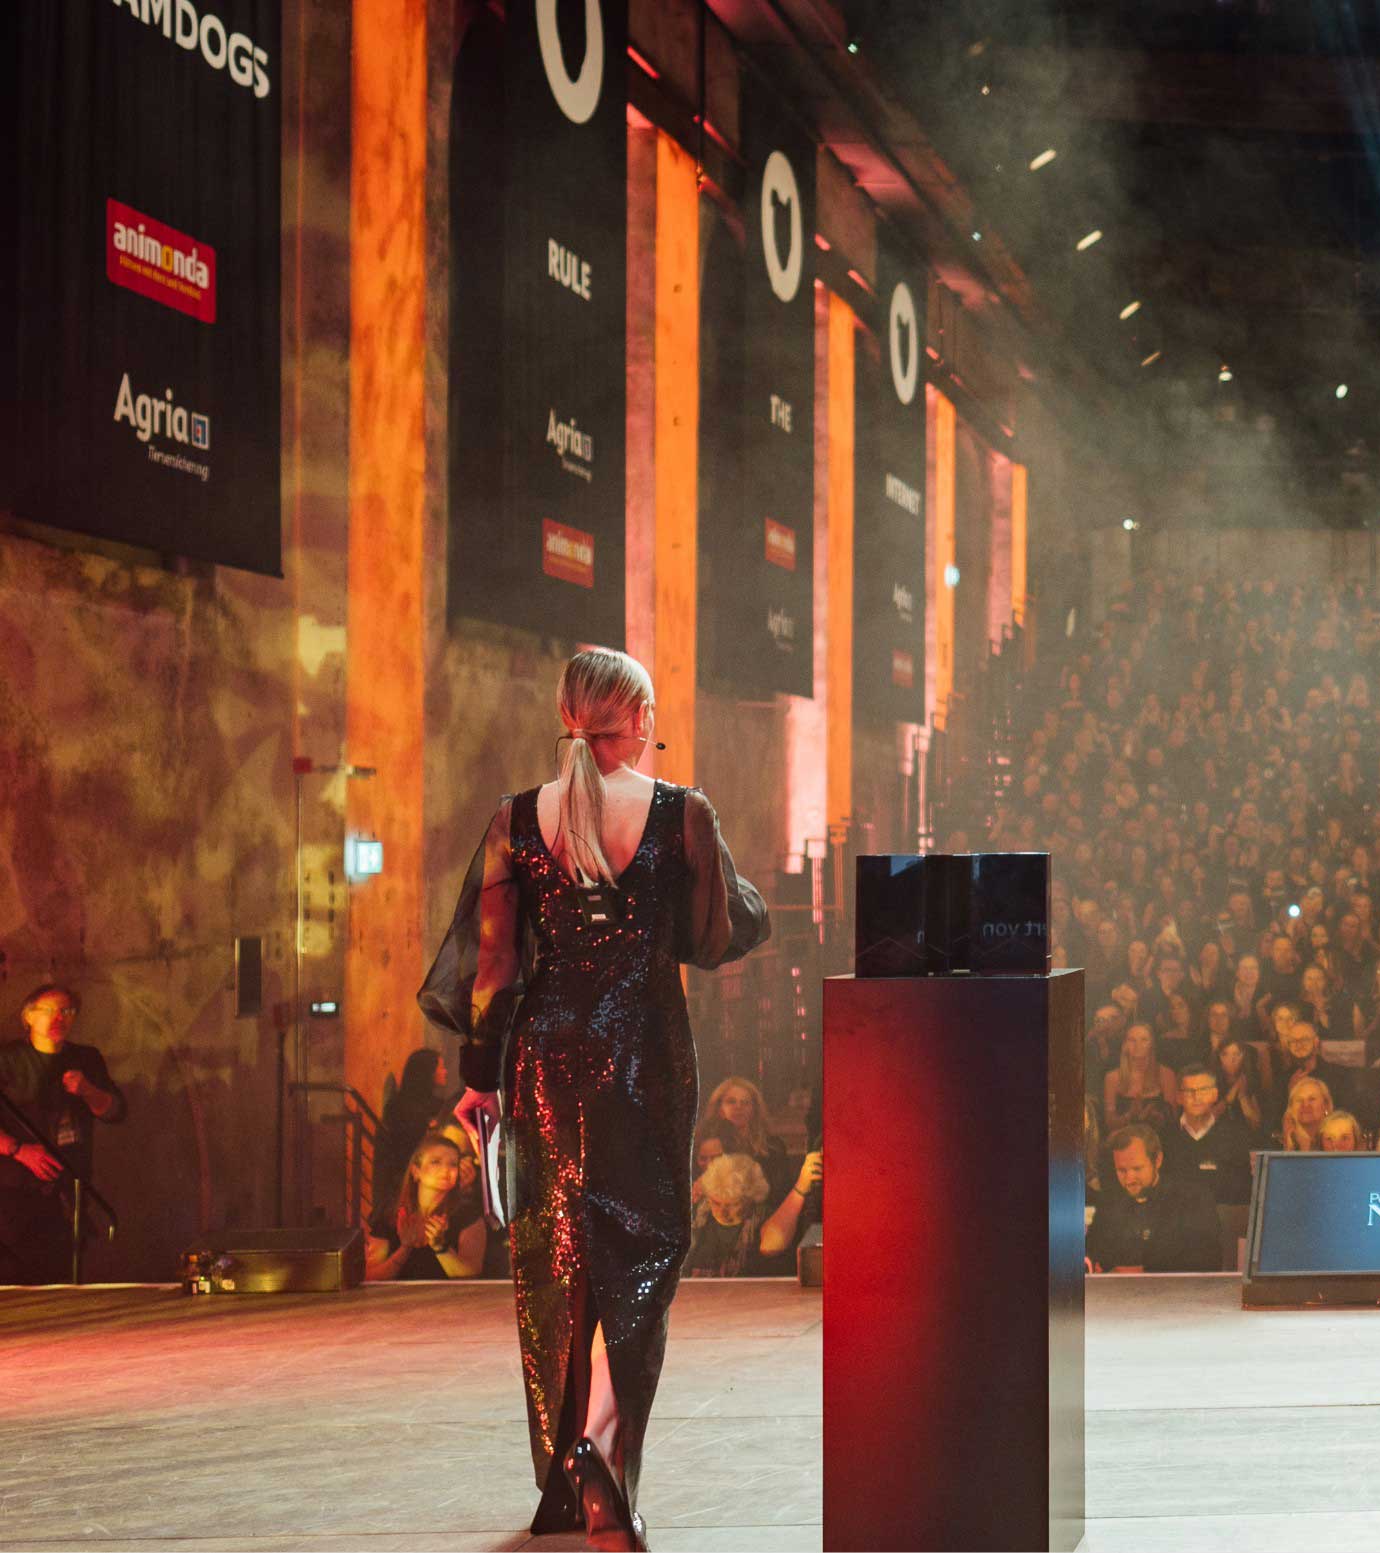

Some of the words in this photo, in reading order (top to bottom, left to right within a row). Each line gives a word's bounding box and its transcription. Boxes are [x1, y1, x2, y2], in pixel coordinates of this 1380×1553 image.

[113, 0, 271, 98] MDOGS
[113, 222, 209, 289] animonda
[548, 238, 592, 301] RULE
[113, 372, 189, 444] Agria
[547, 408, 582, 457] Agria
[770, 394, 793, 433] THE
